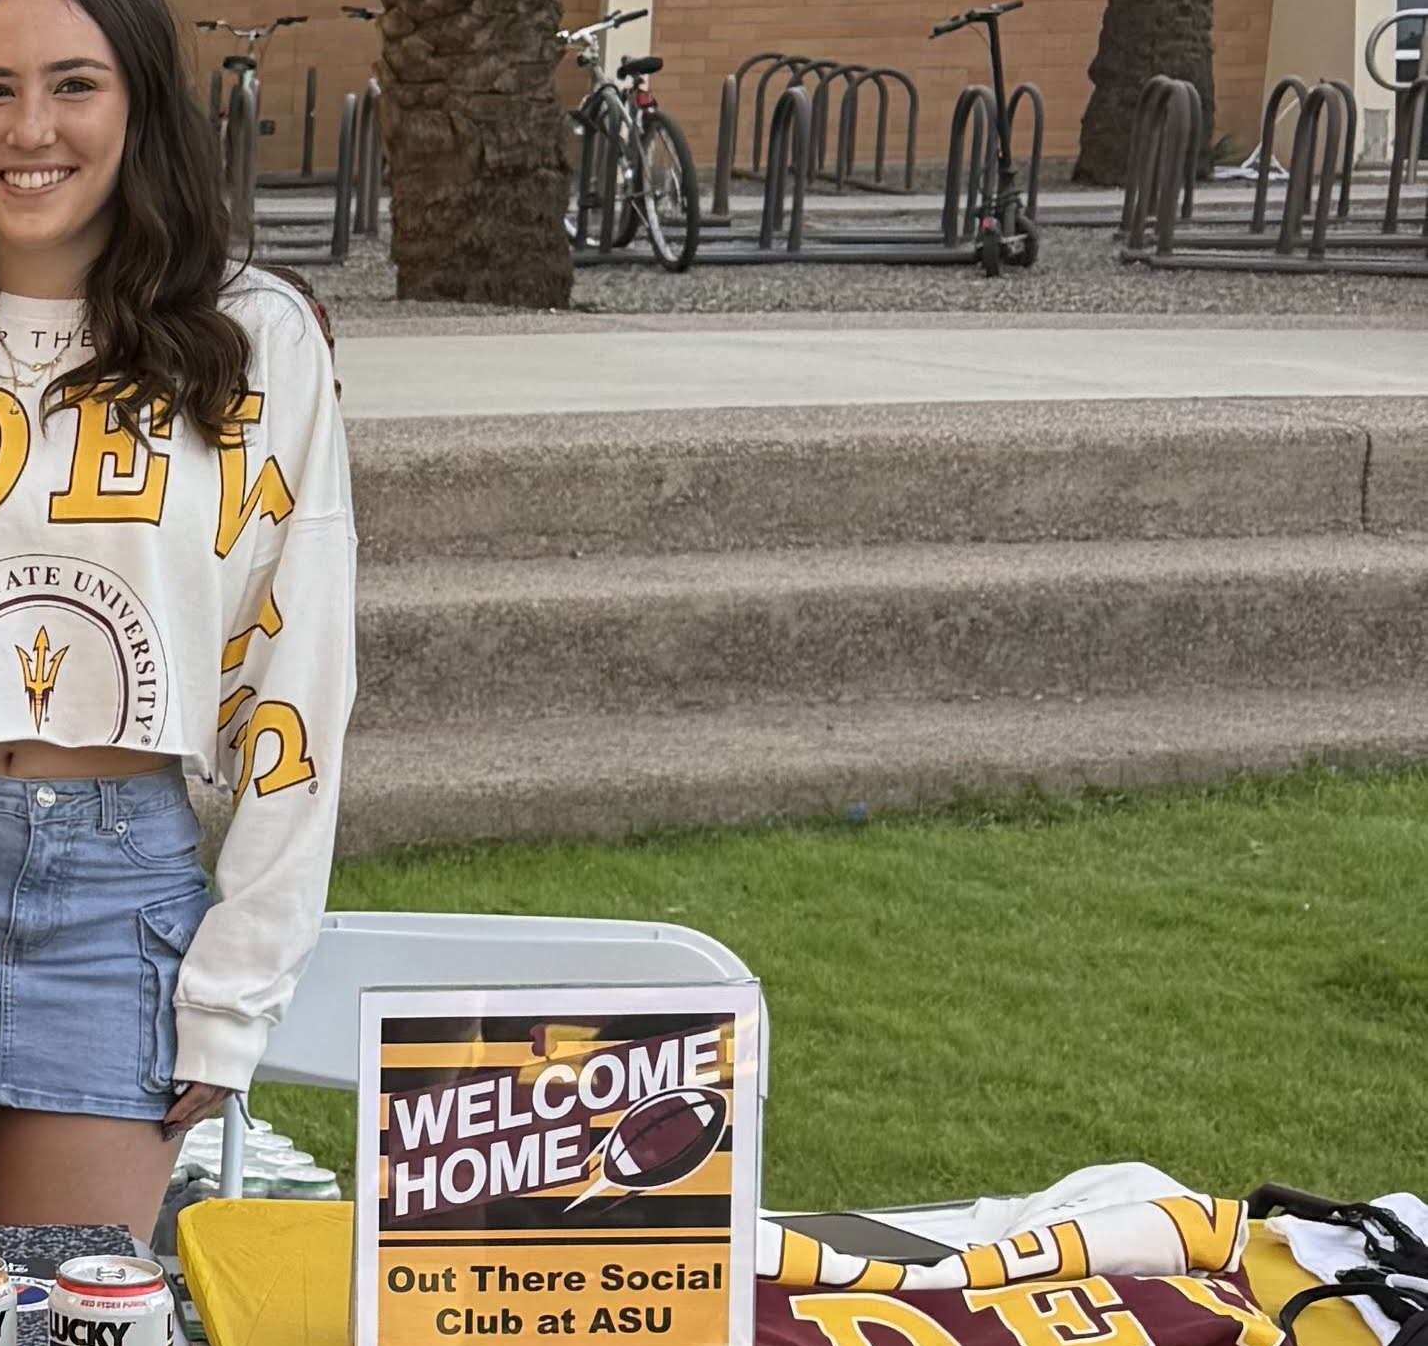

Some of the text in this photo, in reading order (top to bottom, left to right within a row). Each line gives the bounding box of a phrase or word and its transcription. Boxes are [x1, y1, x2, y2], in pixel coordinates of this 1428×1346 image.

[30, 330, 94, 348] THE
[74, 570, 158, 731] UNIVERSITY
[393, 1029, 722, 1151] WELCOME
[395, 1124, 583, 1217] HOME
[387, 1263, 723, 1293] Out There Social
[435, 1307, 673, 1335] Club at ASU
